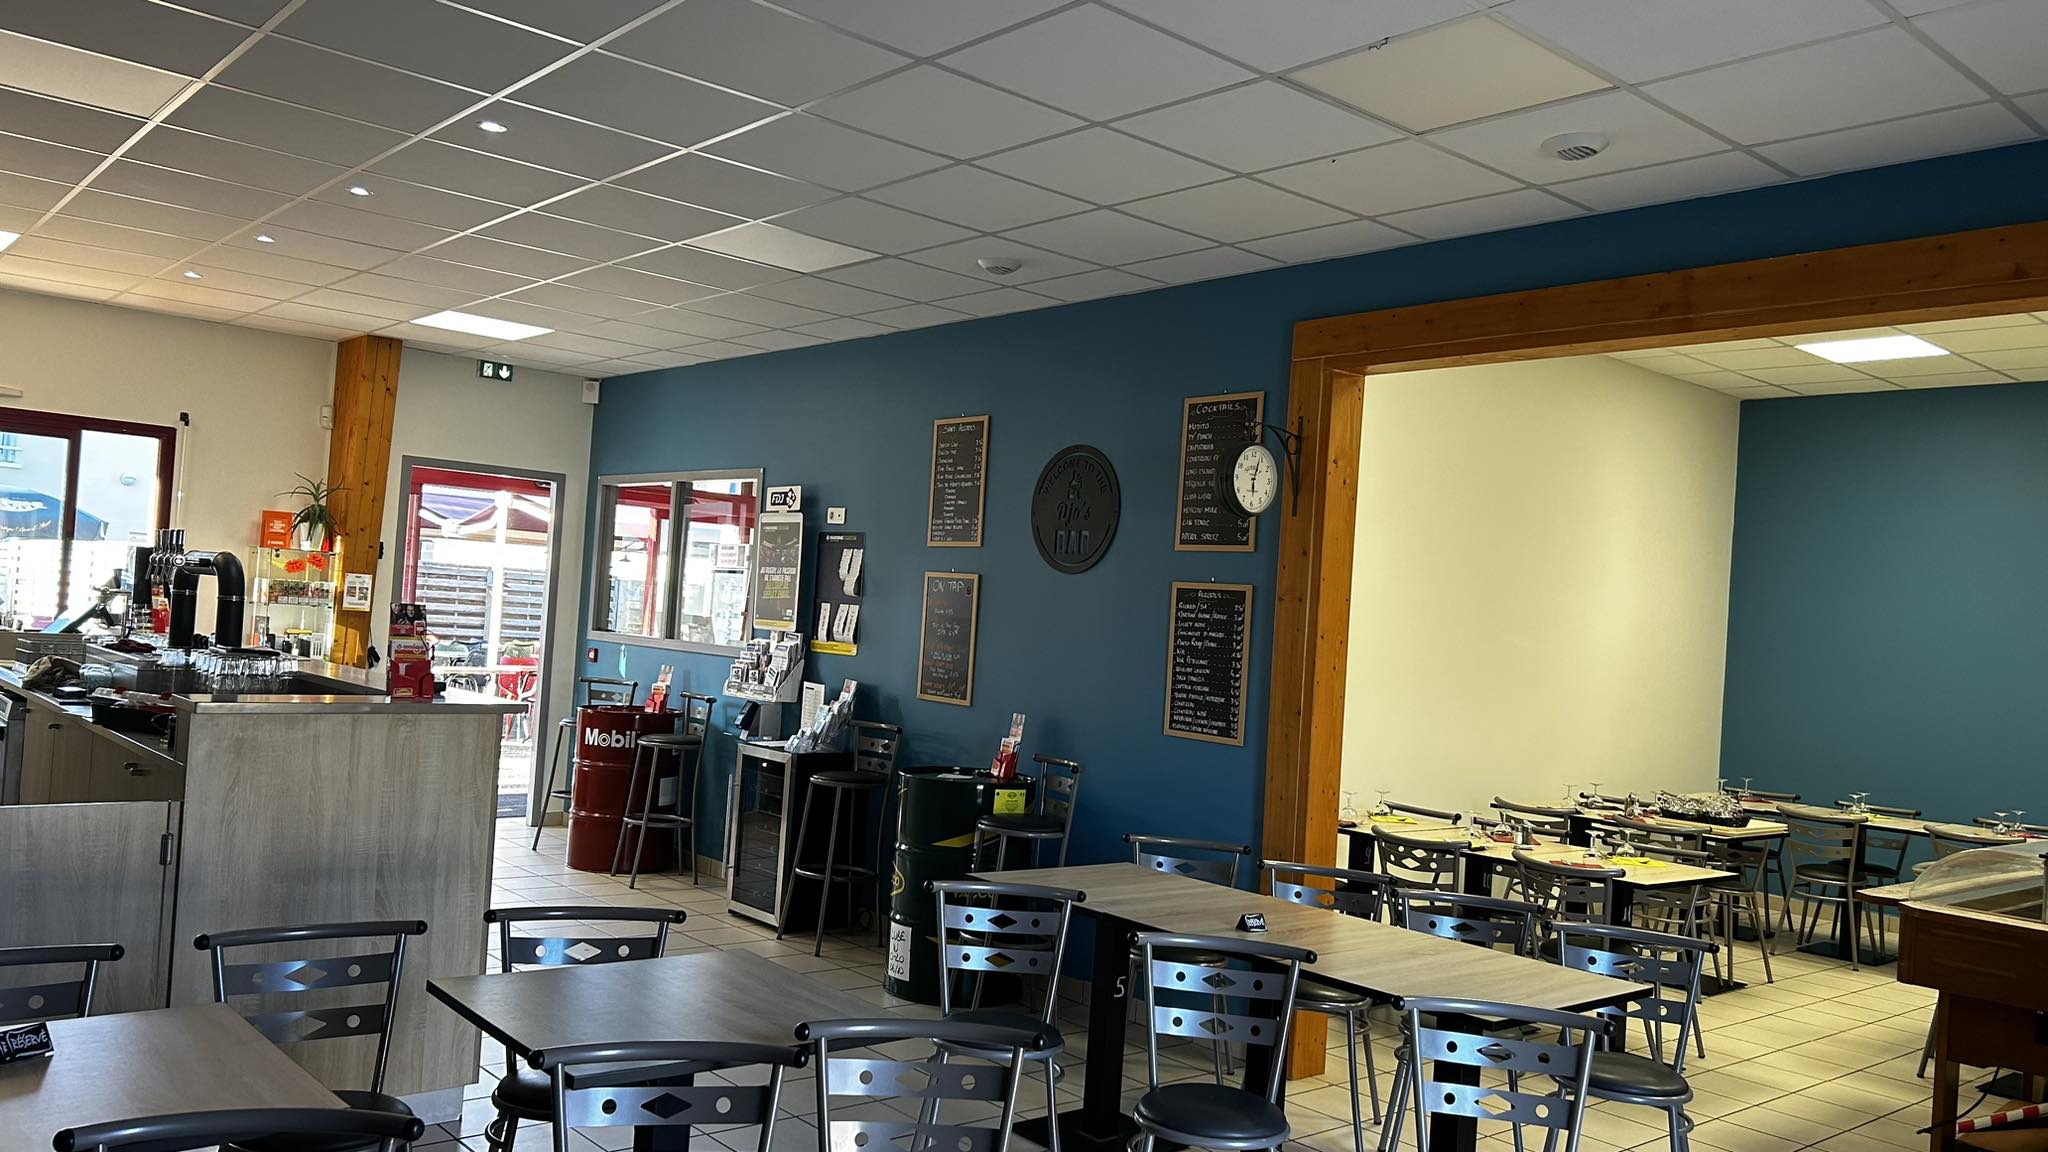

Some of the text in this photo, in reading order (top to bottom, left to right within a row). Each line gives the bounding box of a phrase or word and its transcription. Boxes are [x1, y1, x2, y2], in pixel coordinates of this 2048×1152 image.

[1196, 402, 1240, 414] COCKTAILS
[772, 494, 784, 504] FDJ
[948, 581, 964, 592] TAP
[585, 728, 636, 748] Mobil
[1114, 976, 1126, 998] 5
